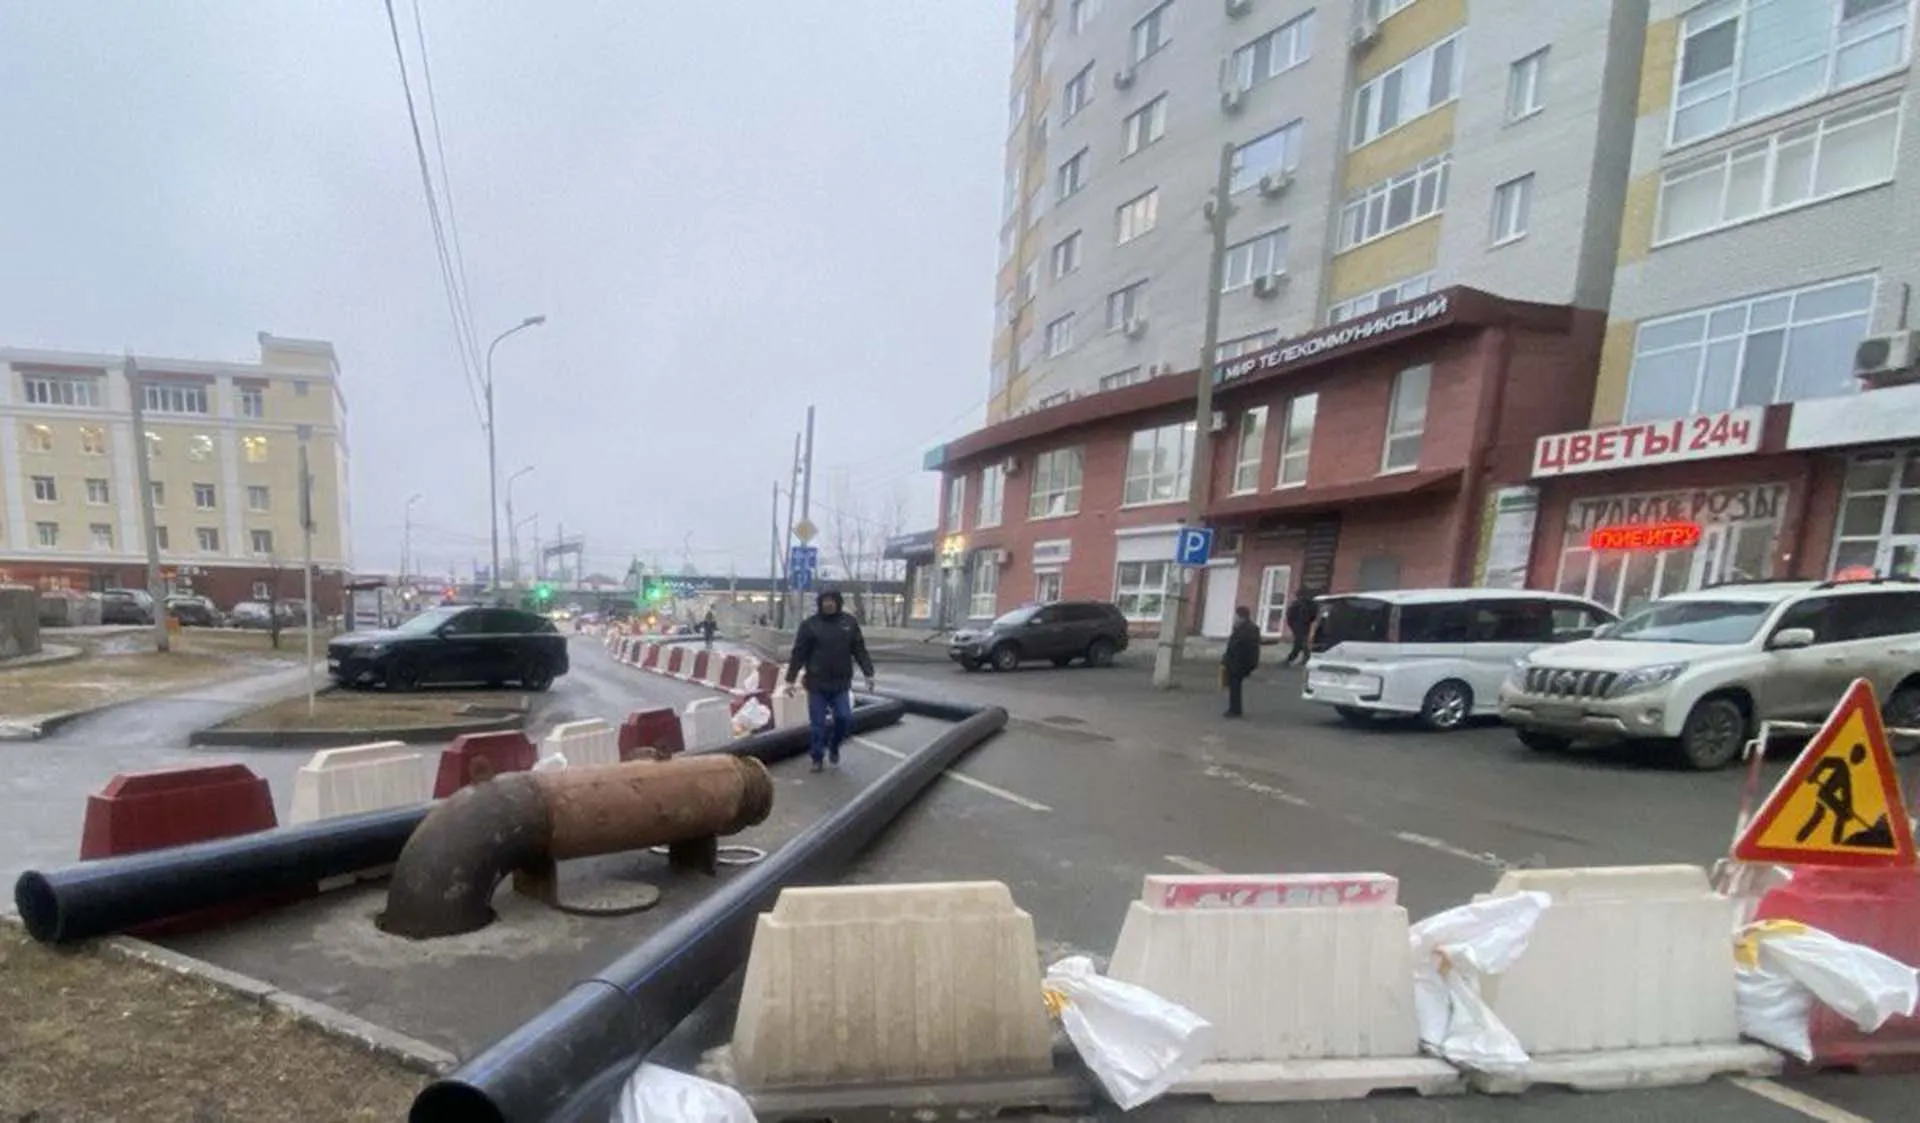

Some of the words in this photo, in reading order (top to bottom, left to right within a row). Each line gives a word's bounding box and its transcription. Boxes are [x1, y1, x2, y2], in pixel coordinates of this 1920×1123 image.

[1224, 362, 1256, 381] МИР
[1259, 295, 1448, 370] ТЕЛЕКОММУНИКАЦИЙ
[1539, 420, 1682, 472] ЦВЕТЫ
[1692, 484, 1783, 521] РОЗЫ
[1183, 531, 1205, 561] P
